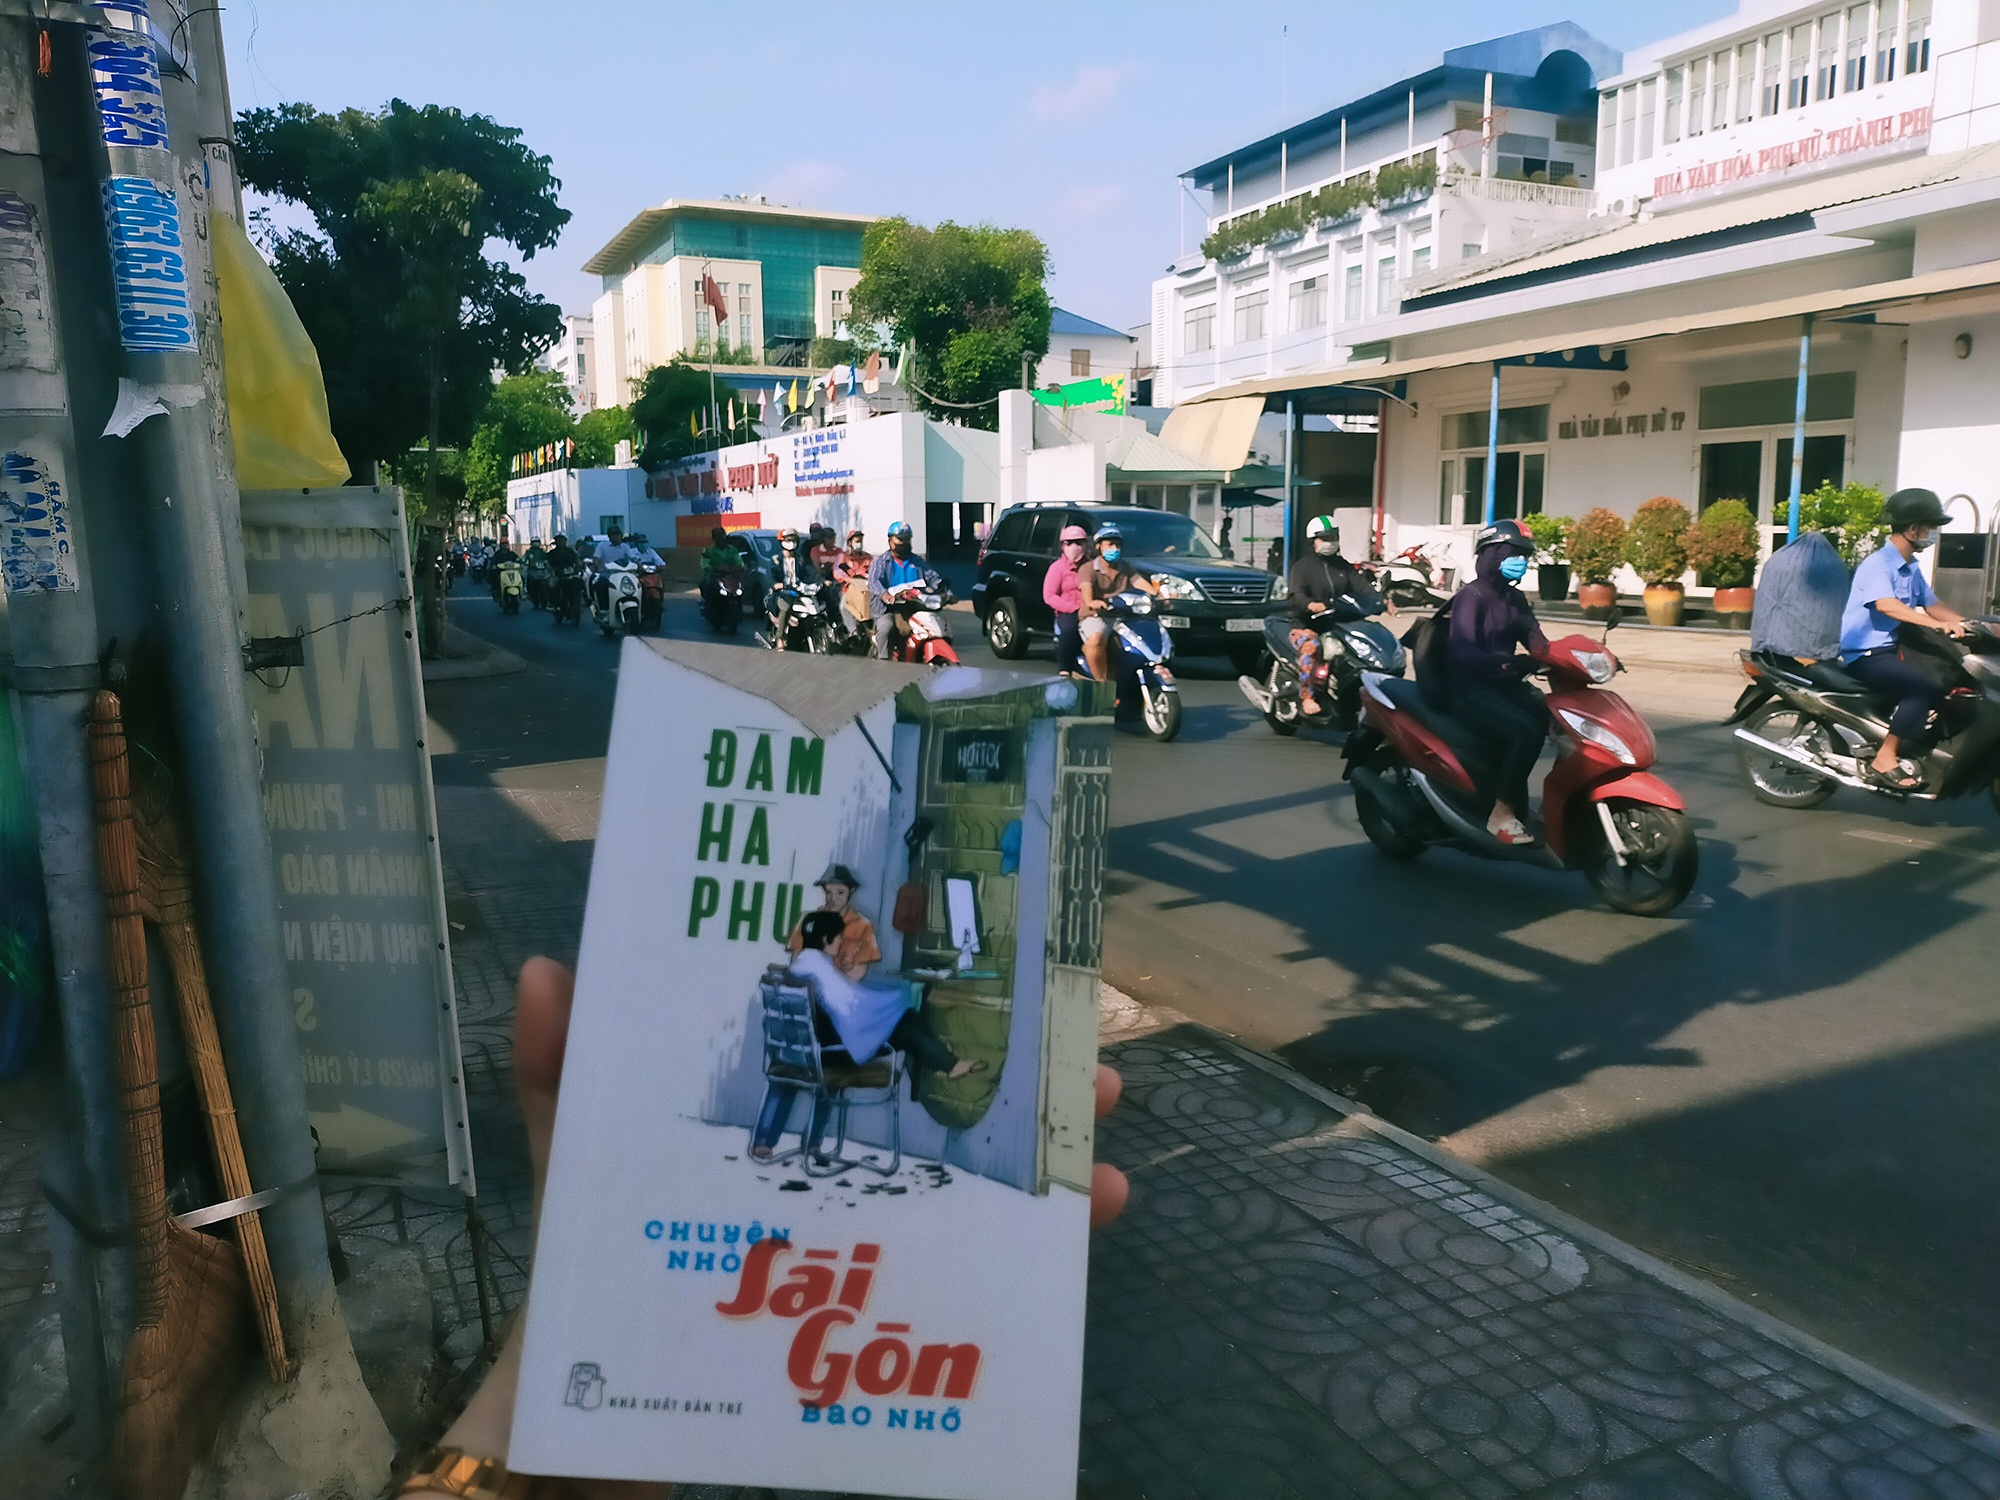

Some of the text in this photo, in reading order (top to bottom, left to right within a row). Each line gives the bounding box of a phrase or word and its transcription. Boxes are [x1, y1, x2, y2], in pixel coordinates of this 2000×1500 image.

[1653, 165, 1684, 198] NHÀ
[1687, 159, 1718, 189] VĂN
[1722, 149, 1752, 181] HÓA
[1826, 117, 1894, 154] THÀNH
